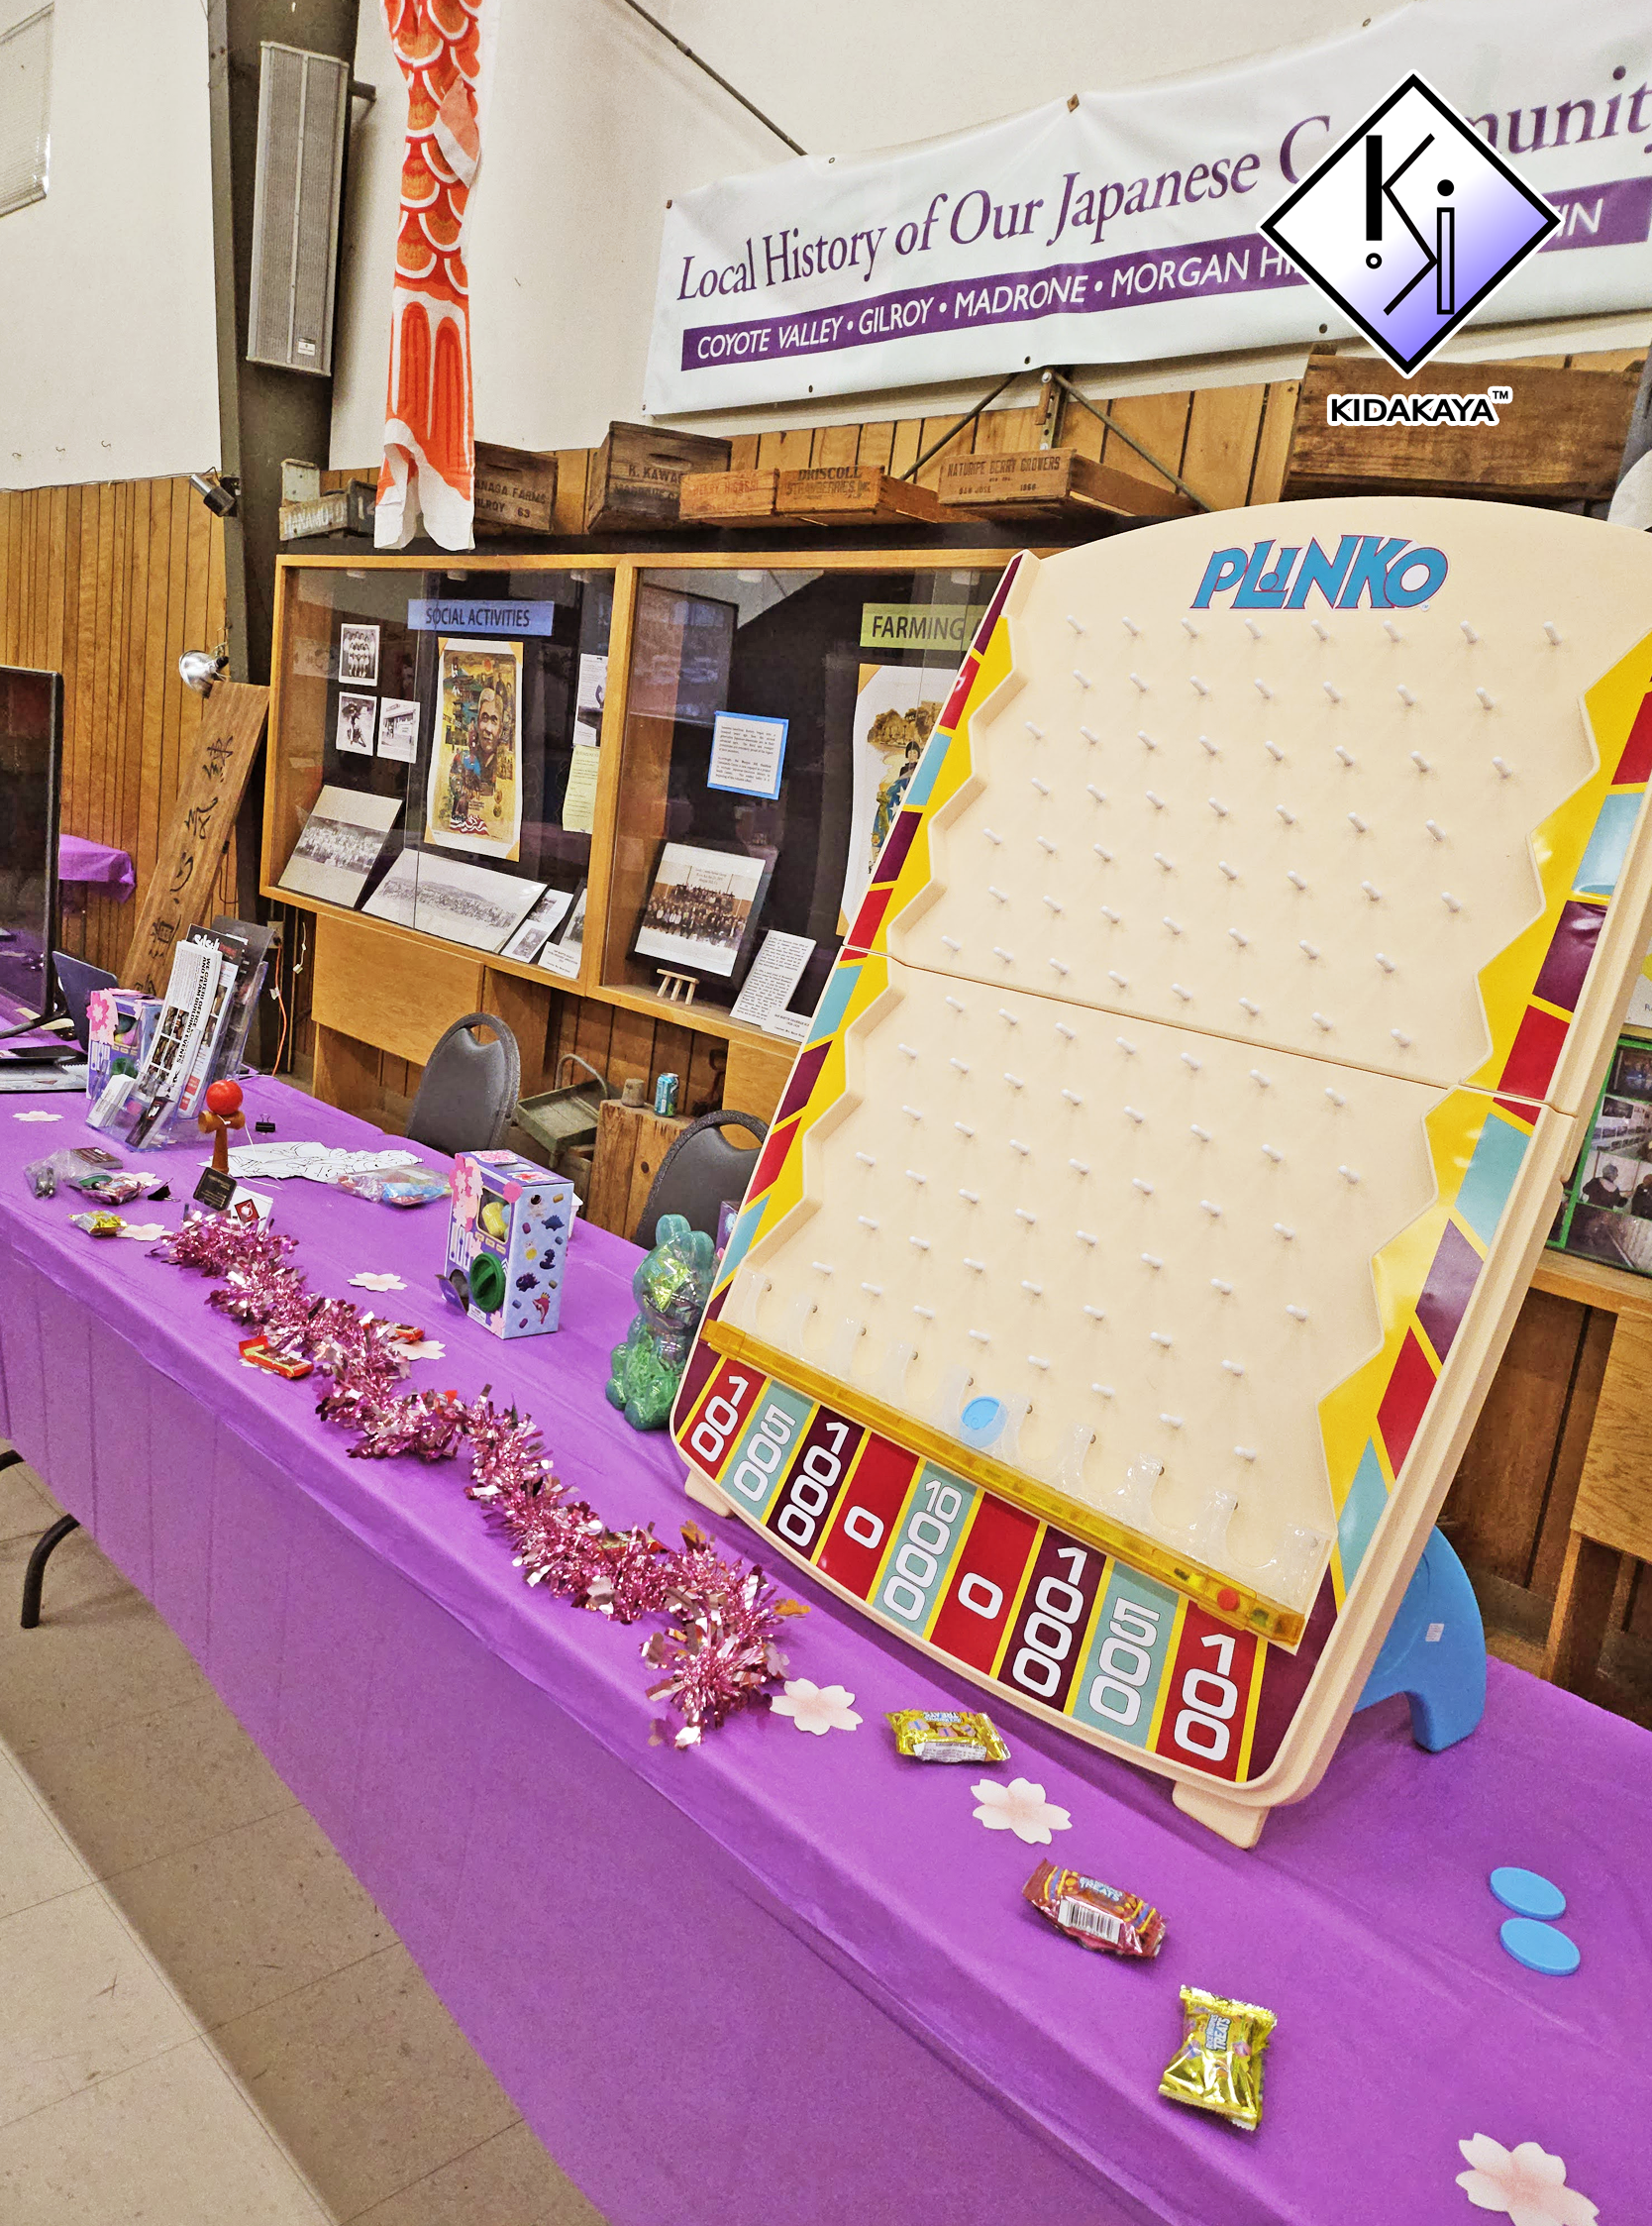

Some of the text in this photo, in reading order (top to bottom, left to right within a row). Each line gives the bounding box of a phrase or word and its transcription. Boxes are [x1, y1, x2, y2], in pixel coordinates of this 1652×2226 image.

[676, 238, 758, 300] Local
[763, 227, 887, 286] History
[895, 193, 949, 256] of
[950, 190, 1044, 245] Our
[1046, 153, 1261, 247] Japanese
[697, 328, 772, 359] COYOTE
[778, 315, 844, 349] VALLEY
[859, 297, 934, 335] GILROY
[954, 274, 1088, 318] MADRONE
[1110, 247, 1250, 297] MORGAN
[512, 487, 547, 504] FARMS
[797, 466, 863, 480] DRISCOLL
[1020, 456, 1061, 472] GROWERS
[425, 607, 531, 628] SOCIAL ACTIVITIES
[872, 615, 966, 641] FARMING
[691, 1375, 750, 1462] 100
[734, 1403, 795, 1502] 500
[777, 1422, 850, 1547] 1000
[844, 1505, 884, 1549] 0
[958, 1572, 1004, 1620] 0
[1012, 1546, 1087, 1698] 1000
[1089, 1597, 1161, 1726] 500
[1174, 1634, 1237, 1761] 100
[1213, 2016, 1232, 2051] TREATS
